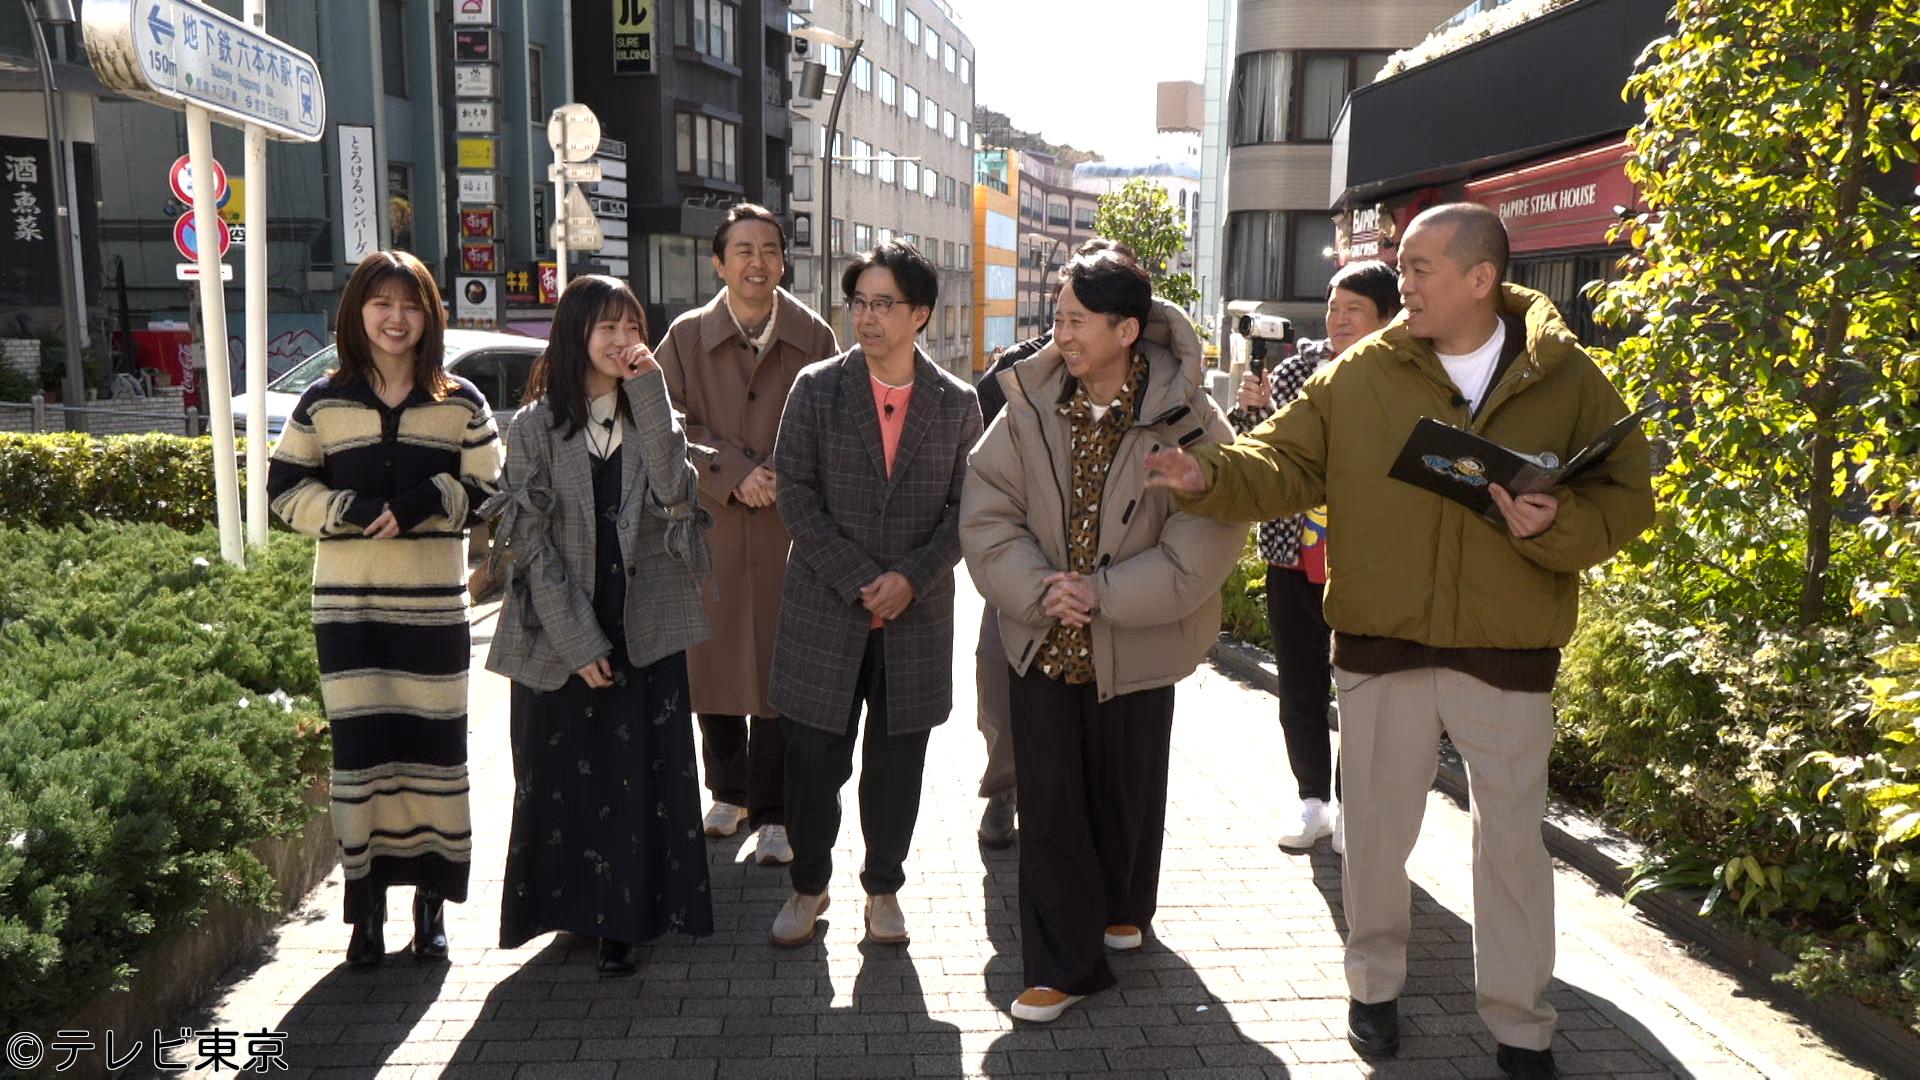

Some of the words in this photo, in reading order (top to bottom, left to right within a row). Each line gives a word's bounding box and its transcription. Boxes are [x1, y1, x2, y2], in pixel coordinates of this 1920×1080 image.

[183, 11, 293, 88] 地下鉄六本木駅
[616, 37, 640, 48] SURE
[149, 50, 177, 77] 150m
[1500, 200, 1529, 219] EMPIRE
[1530, 191, 1558, 214] STEAK
[1559, 183, 1597, 209] HOUSE
[506, 271, 529, 293] 牛丼
